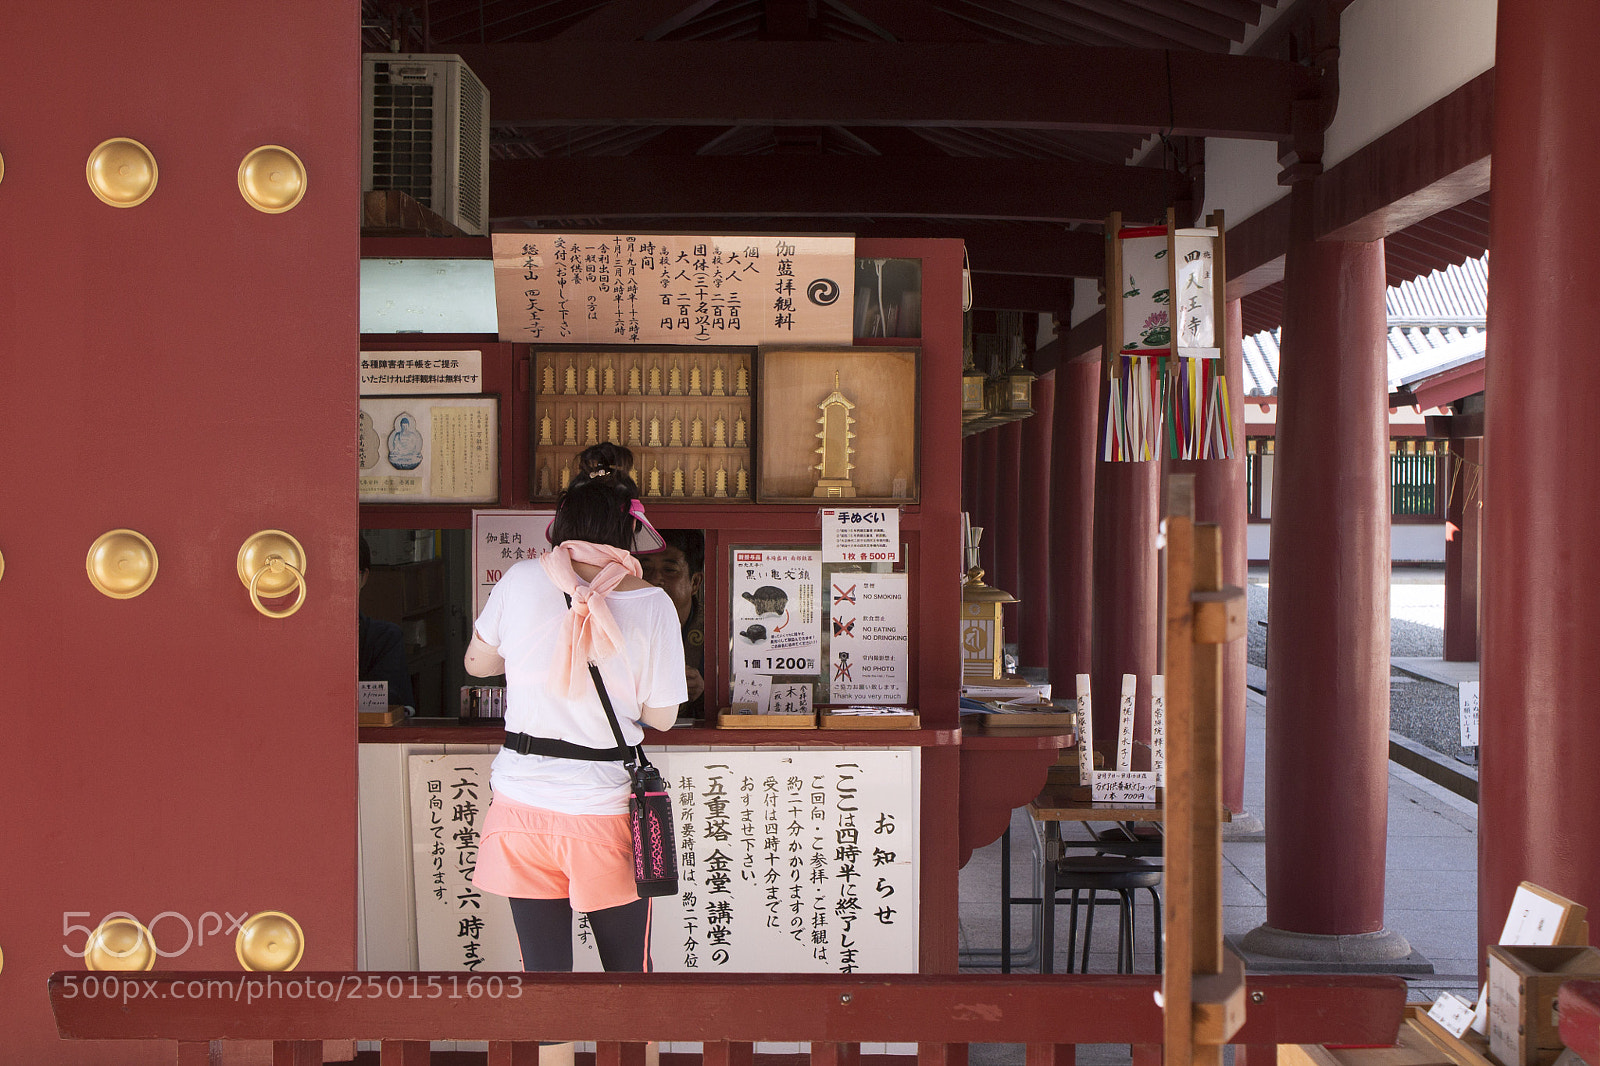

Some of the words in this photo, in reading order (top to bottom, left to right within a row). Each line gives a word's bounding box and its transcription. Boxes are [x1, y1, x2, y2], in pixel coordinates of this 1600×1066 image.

[639, 241, 656, 270] 時間
[743, 246, 760, 274] 個人
[774, 240, 796, 331] 伽藍拝観料
[523, 289, 545, 339] 四天王寺
[676, 292, 691, 330] 二百円
[712, 293, 725, 331] 二百円
[727, 292, 742, 331] 三百円
[361, 359, 459, 369] 各種障害者手帳をご提示
[361, 375, 479, 384] いただければ拝観料は無料です
[838, 511, 885, 524] 手ぬぐい
[486, 532, 522, 545] 伽藍内
[873, 812, 897, 925] お知らせ
